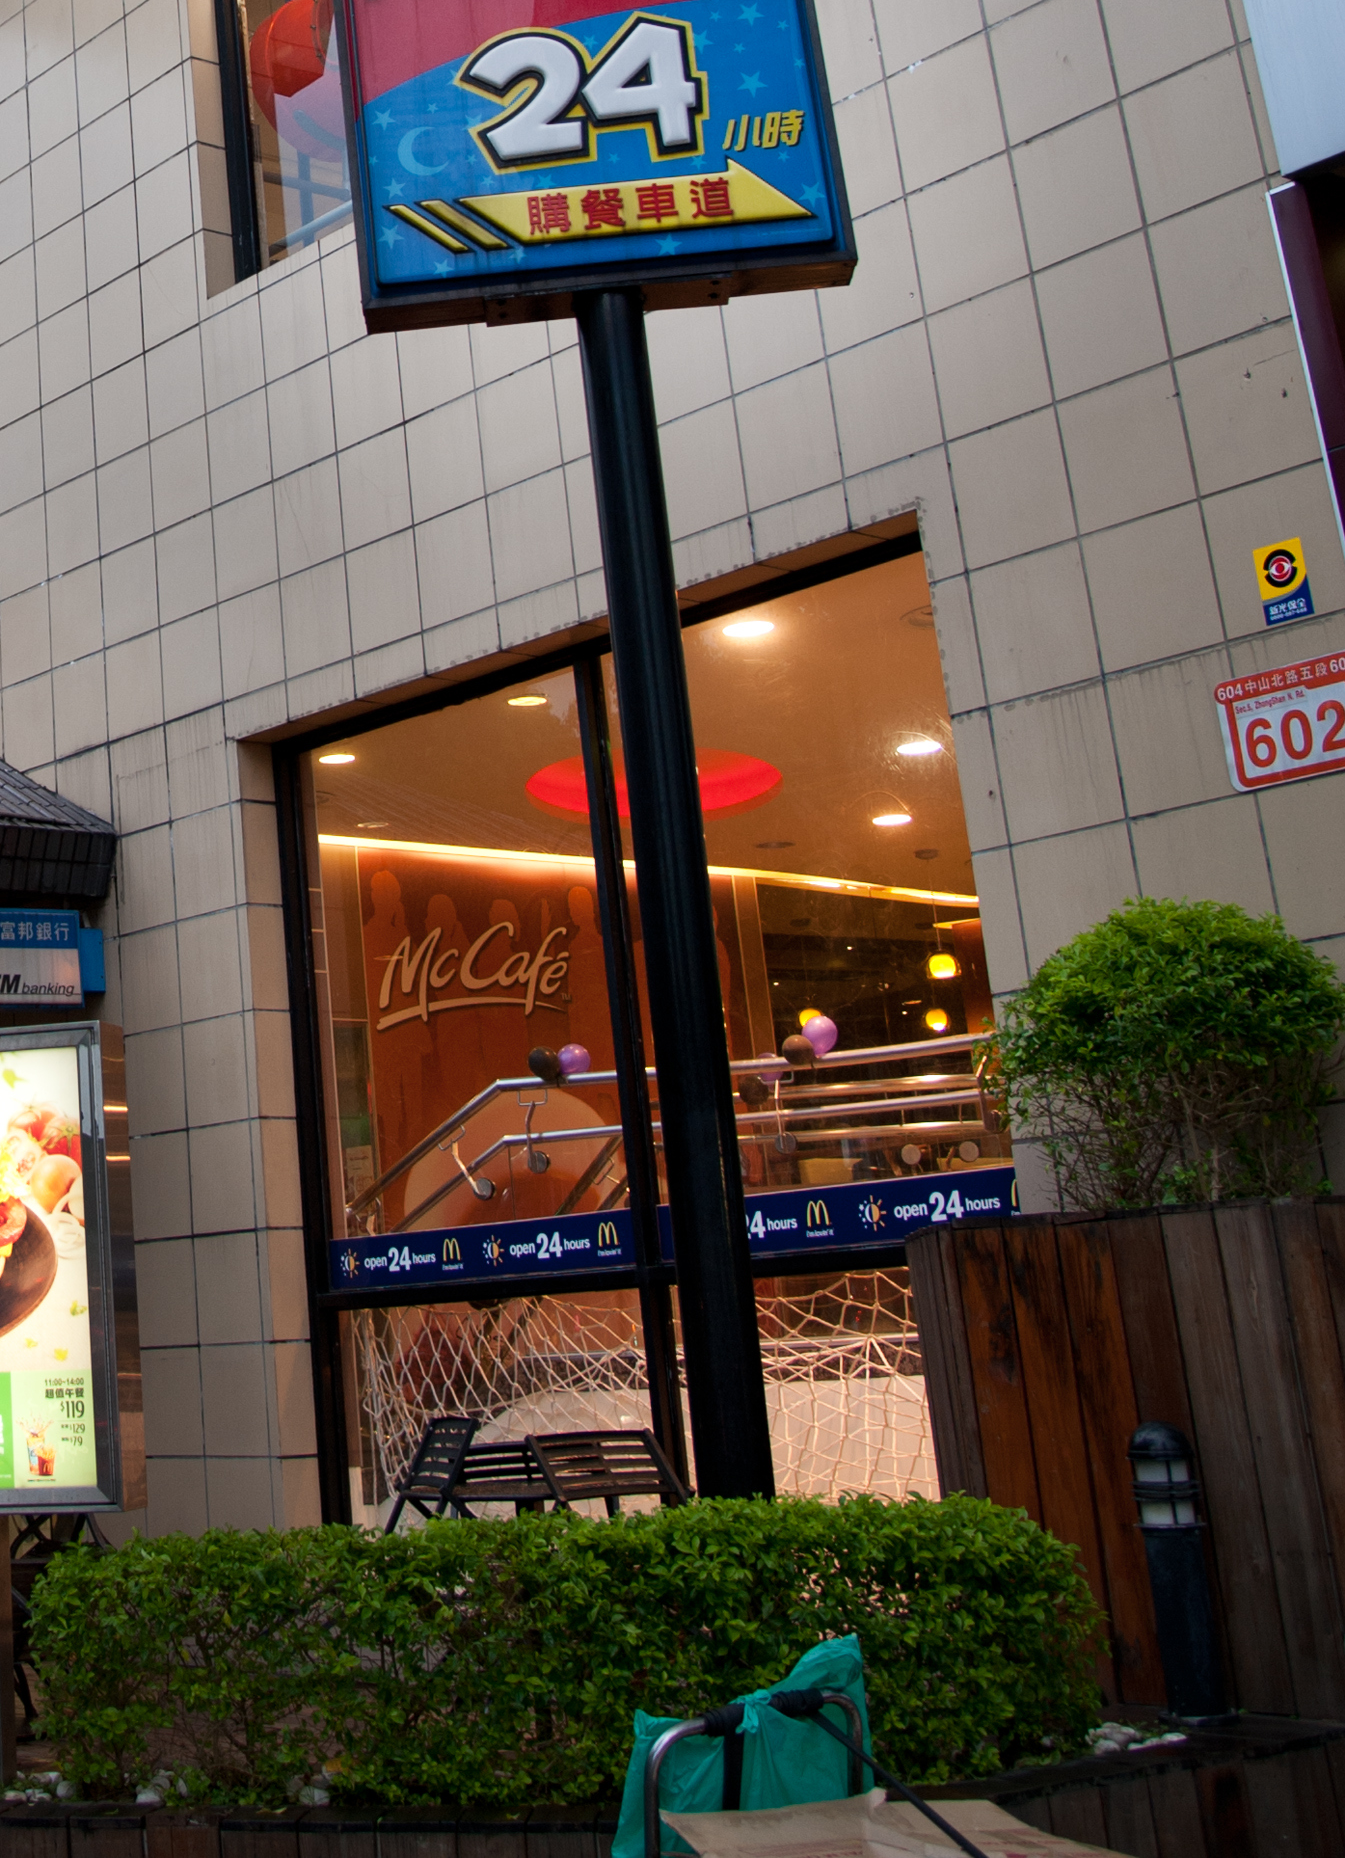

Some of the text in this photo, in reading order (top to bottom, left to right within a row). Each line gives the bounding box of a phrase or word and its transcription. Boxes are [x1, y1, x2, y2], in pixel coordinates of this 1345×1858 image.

[461, 16, 702, 168] 24
[722, 109, 805, 153] 小時
[527, 176, 735, 236] 購餐車道
[1217, 683, 1244, 701] 604
[1244, 663, 1328, 694] 中山北路五段
[1245, 699, 1345, 768] 602
[379, 921, 570, 1022] McCafé
[22, 982, 75, 997] banking
[893, 1189, 1001, 1222] open 24 hours
[745, 1210, 766, 1239] 4
[766, 1217, 798, 1232] hours
[363, 1256, 388, 1270] open
[388, 1246, 412, 1272] 24
[412, 1251, 436, 1265] hours
[509, 1242, 536, 1258] open
[536, 1232, 563, 1259] 24
[563, 1237, 591, 1252] hours
[60, 1400, 85, 1419] $119
